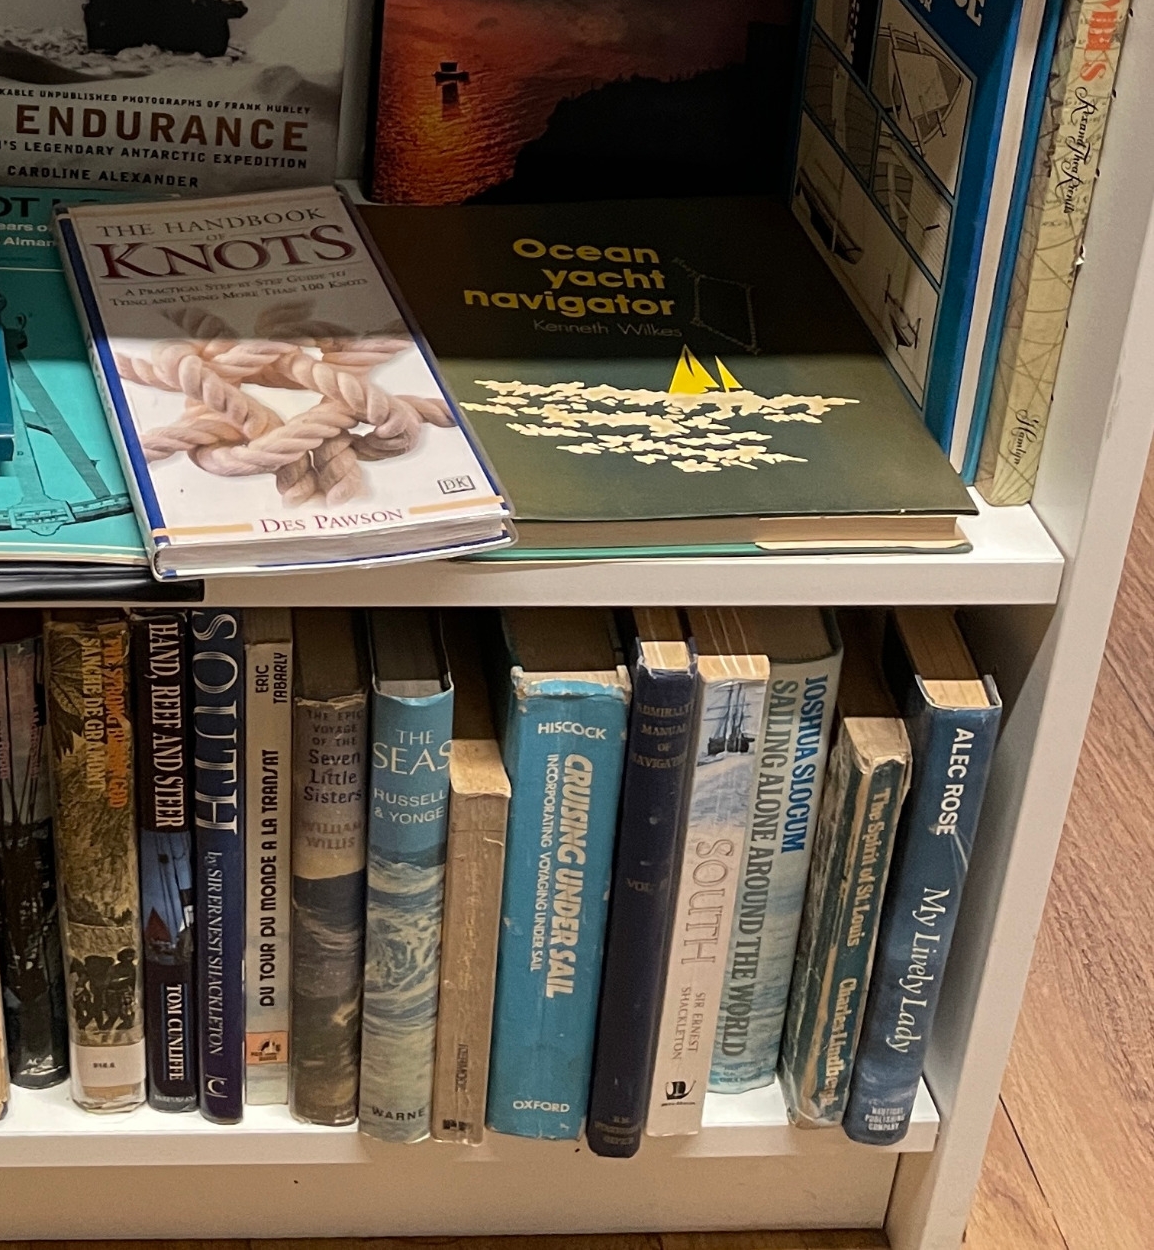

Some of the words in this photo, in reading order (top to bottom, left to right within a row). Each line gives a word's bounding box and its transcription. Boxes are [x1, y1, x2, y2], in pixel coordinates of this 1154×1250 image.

[40, 90, 117, 102] UNPUBLISHED
[122, 95, 202, 108] PHOTOGRAPHS
[207, 100, 219, 108] OF
[224, 101, 261, 111] FRANK
[266, 105, 311, 114] HURLEY
[16, 104, 308, 151] ENDURANCE
[24, 142, 114, 157] LEGENDARY
[120, 148, 206, 162] ANTARCTIC
[213, 154, 307, 168] EXPEDITION
[7, 165, 91, 180] CAROLINE
[98, 170, 199, 189] ALEXANDER
[97, 224, 154, 239] THE
[166, 207, 326, 235] HANDBOOK
[93, 225, 358, 278] KNOTS
[513, 238, 660, 265] Ocean
[542, 269, 665, 289] yacht
[463, 288, 675, 318] navigator
[534, 319, 610, 335] Kenneth
[616, 323, 683, 338] Wilkes
[259, 518, 305, 534] DES
[315, 508, 403, 530] PAWSON
[255, 664, 269, 694] ERIC
[273, 652, 289, 705] TABARLY
[191, 612, 238, 835] SOUTH
[395, 730, 434, 745] THE
[538, 722, 606, 740] HISCOCK
[758, 679, 798, 771] SAILING
[796, 674, 829, 762] JOSHUA
[308, 749, 362, 767] Seven
[373, 740, 453, 775] SEAS
[945, 728, 975, 779] ALEC
[303, 785, 362, 804] Sisters
[308, 768, 358, 787] Little
[374, 788, 448, 806] RUSSELL
[559, 753, 593, 865] CRUISING
[748, 771, 782, 845] ALONE
[782, 761, 817, 853] SLOCUM
[939, 782, 964, 836] ROSE
[550, 865, 588, 945] UNDER
[680, 838, 736, 965] SOUTH
[739, 845, 774, 937] AROUND
[923, 887, 950, 927] My
[546, 946, 576, 998] SAIL
[733, 938, 760, 981] THE
[903, 926, 941, 991] Lively
[164, 984, 182, 1020] TOM
[721, 982, 757, 1057] WORLD
[886, 991, 929, 1053] Lady
[672, 987, 690, 1059] SHACKLETON
[167, 1021, 190, 1081] CUNLIFFE
[370, 1107, 426, 1120] WARNE
[512, 1100, 570, 1114] OXFORD
